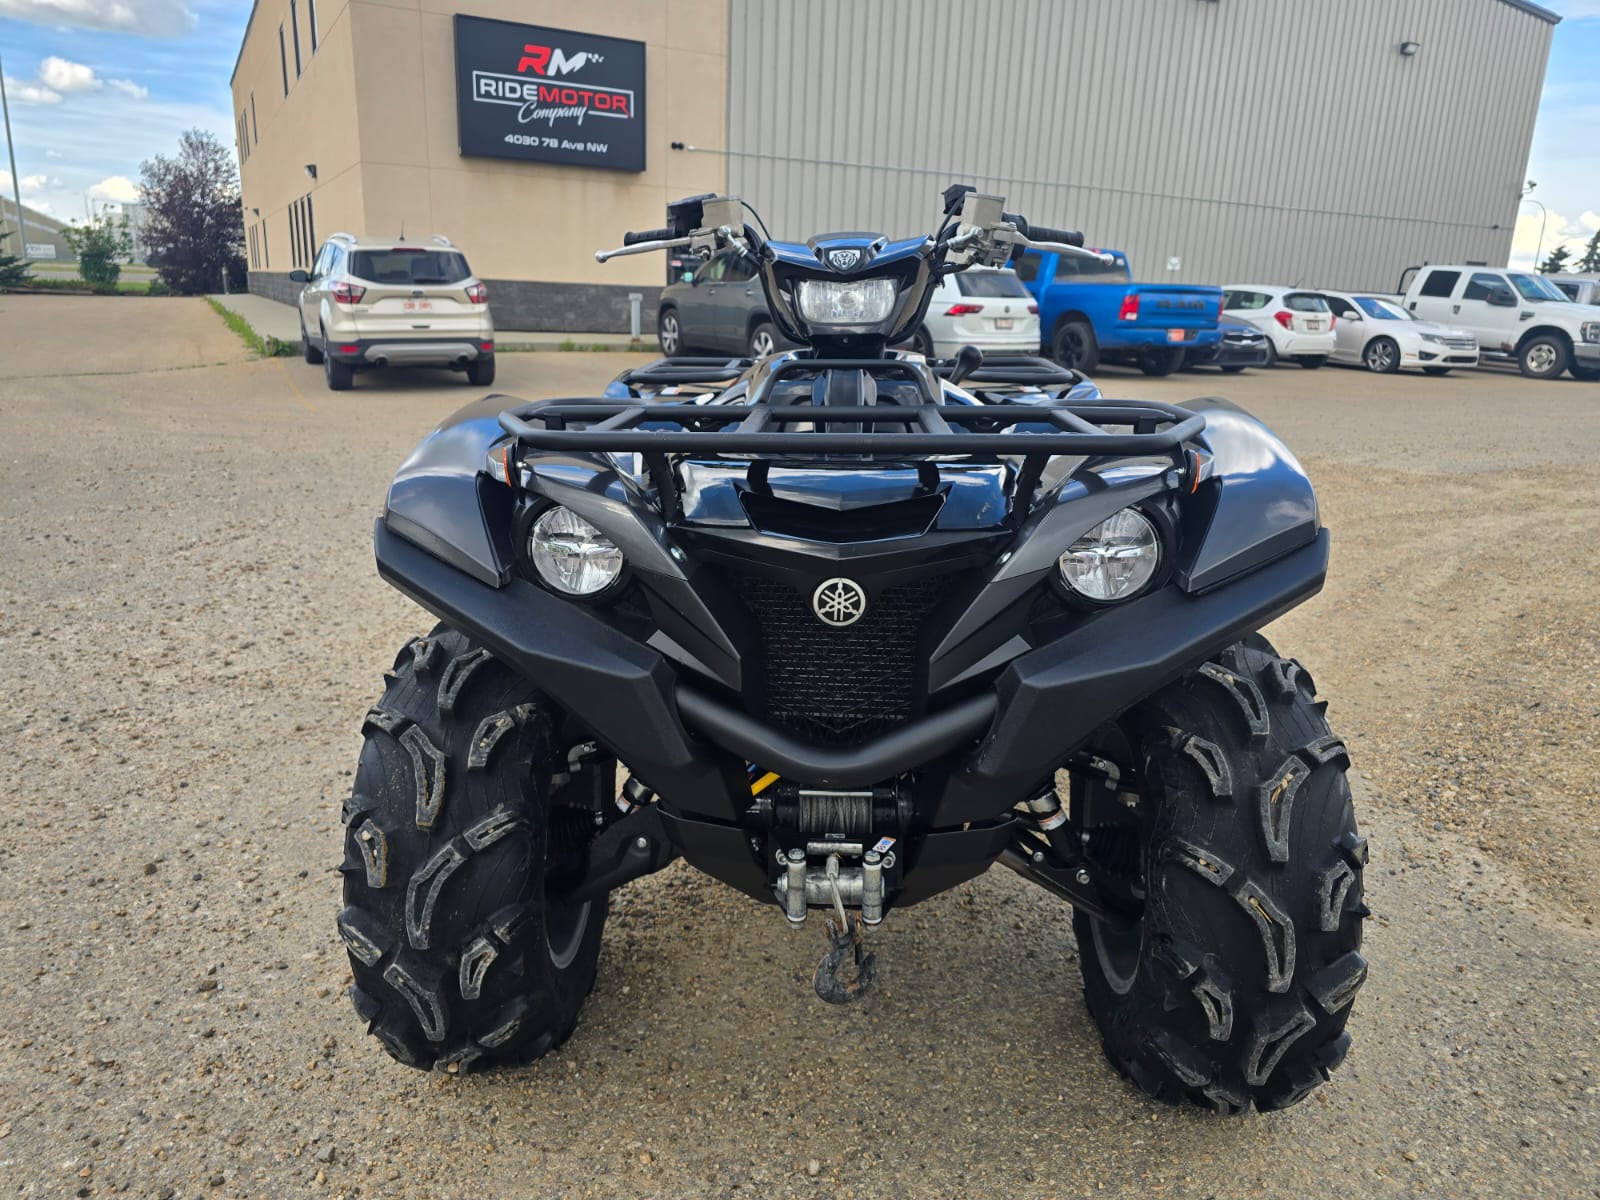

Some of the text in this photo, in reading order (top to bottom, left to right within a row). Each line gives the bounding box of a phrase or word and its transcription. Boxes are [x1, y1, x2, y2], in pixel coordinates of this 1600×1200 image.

[517, 44, 588, 76] RM
[518, 101, 587, 127] Company
[504, 134, 609, 153] 4030 78 Ave NW
[1157, 299, 1206, 310] RAM
